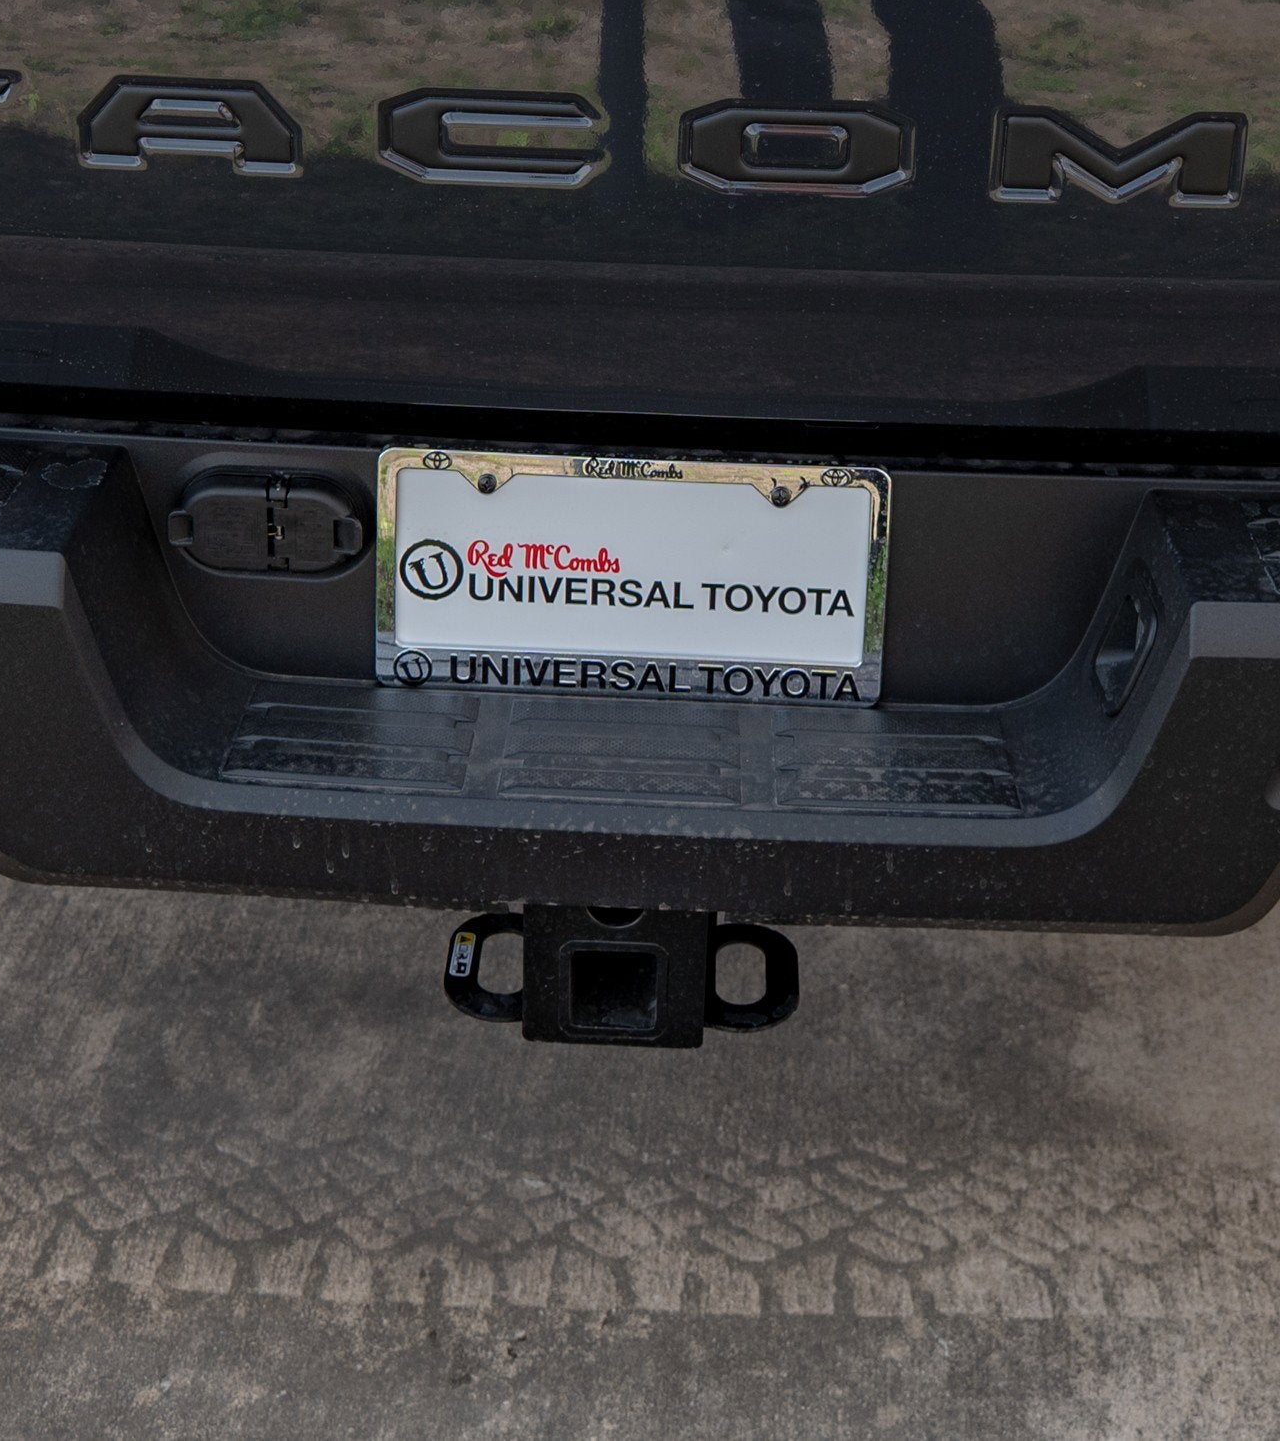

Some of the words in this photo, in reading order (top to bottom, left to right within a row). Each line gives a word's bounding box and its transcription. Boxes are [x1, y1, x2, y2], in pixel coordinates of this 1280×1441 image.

[584, 457, 615, 479] Red
[617, 460, 683, 479] McCombs
[467, 539, 513, 578] Red
[517, 542, 620, 574] McCombs
[468, 572, 695, 610] UNIVERSAL
[701, 582, 855, 618] TOYOTA
[449, 653, 692, 693] UNIVERSAL
[697, 663, 861, 702] TOYOTA
